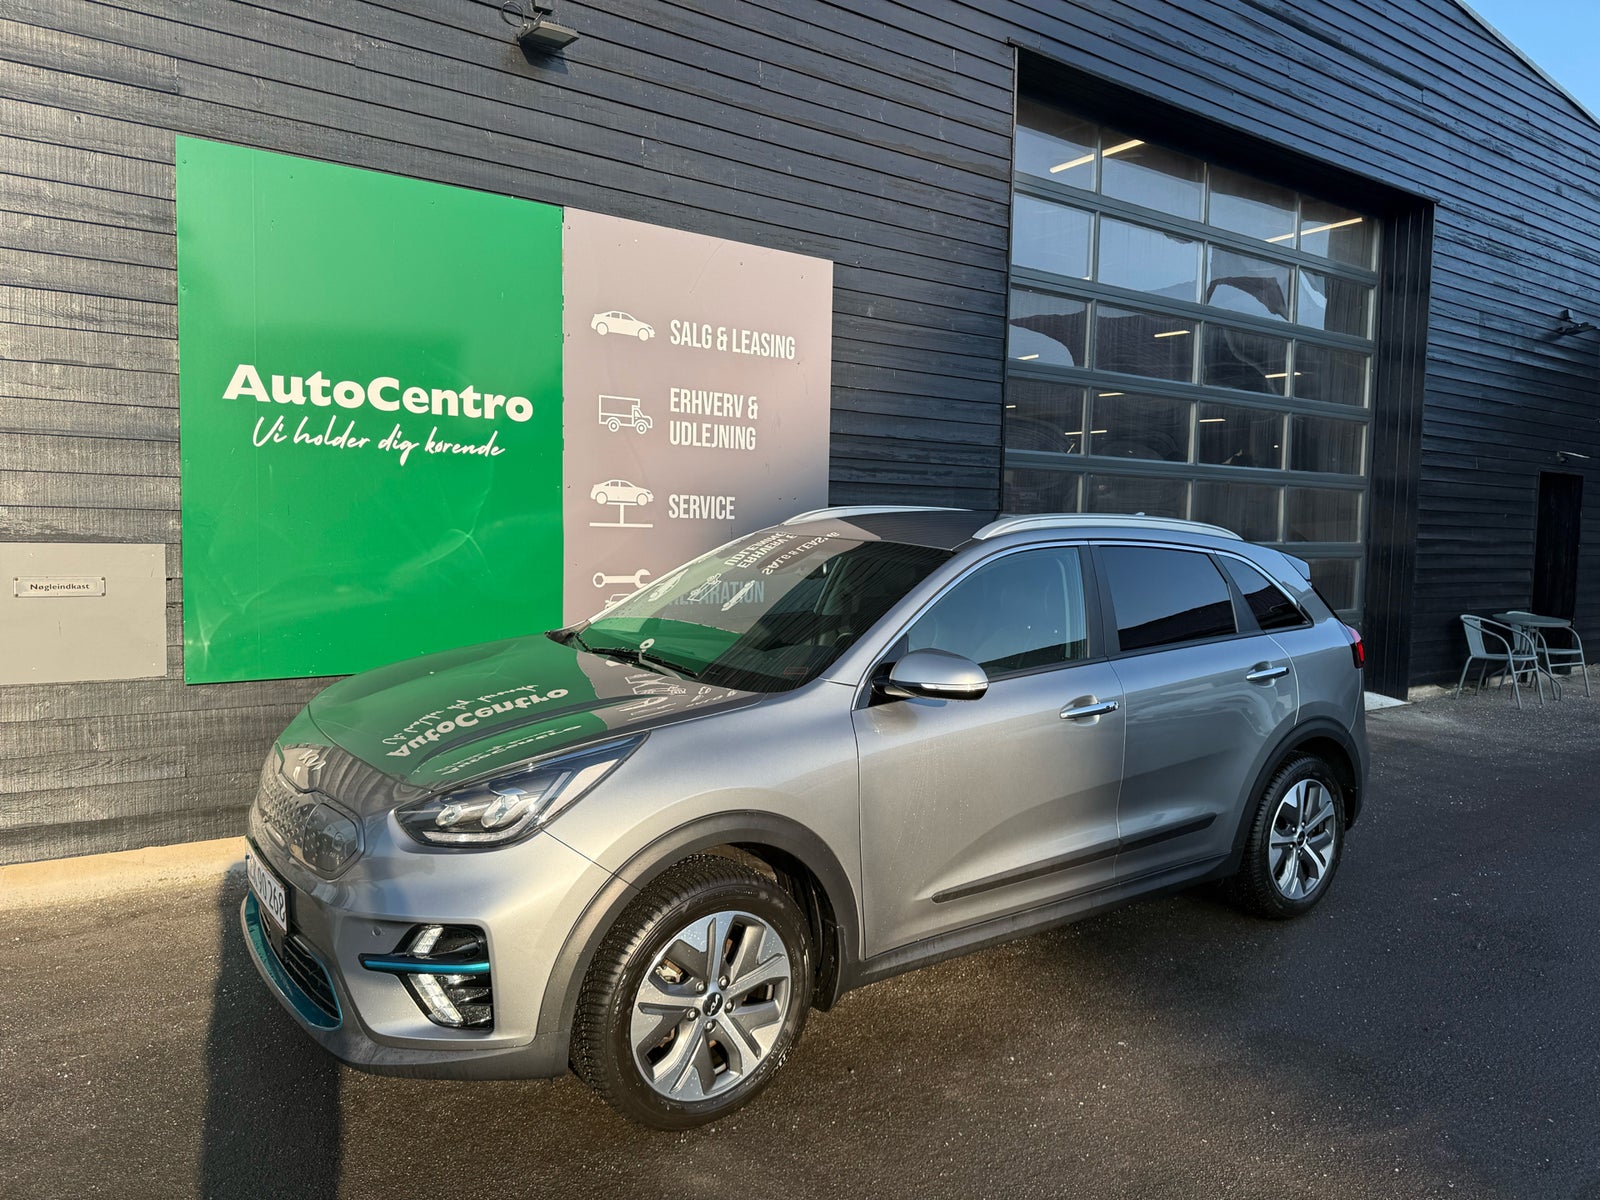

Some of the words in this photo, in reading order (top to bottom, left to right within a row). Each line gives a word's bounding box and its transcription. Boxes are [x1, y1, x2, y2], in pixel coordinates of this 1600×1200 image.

[670, 319, 713, 349] SALG
[716, 326, 728, 351] &
[732, 328, 796, 360] LEASING
[222, 364, 534, 422] AutoCentro
[670, 387, 744, 418] ERHVERV
[747, 396, 759, 420] &
[252, 414, 288, 448] Vi
[293, 414, 371, 449] holder
[377, 423, 420, 466] dig
[424, 426, 506, 457] kørende
[669, 420, 756, 451] UDLEJNING
[668, 493, 736, 520] SERVICE
[30, 583, 90, 591] Nøgleindkast
